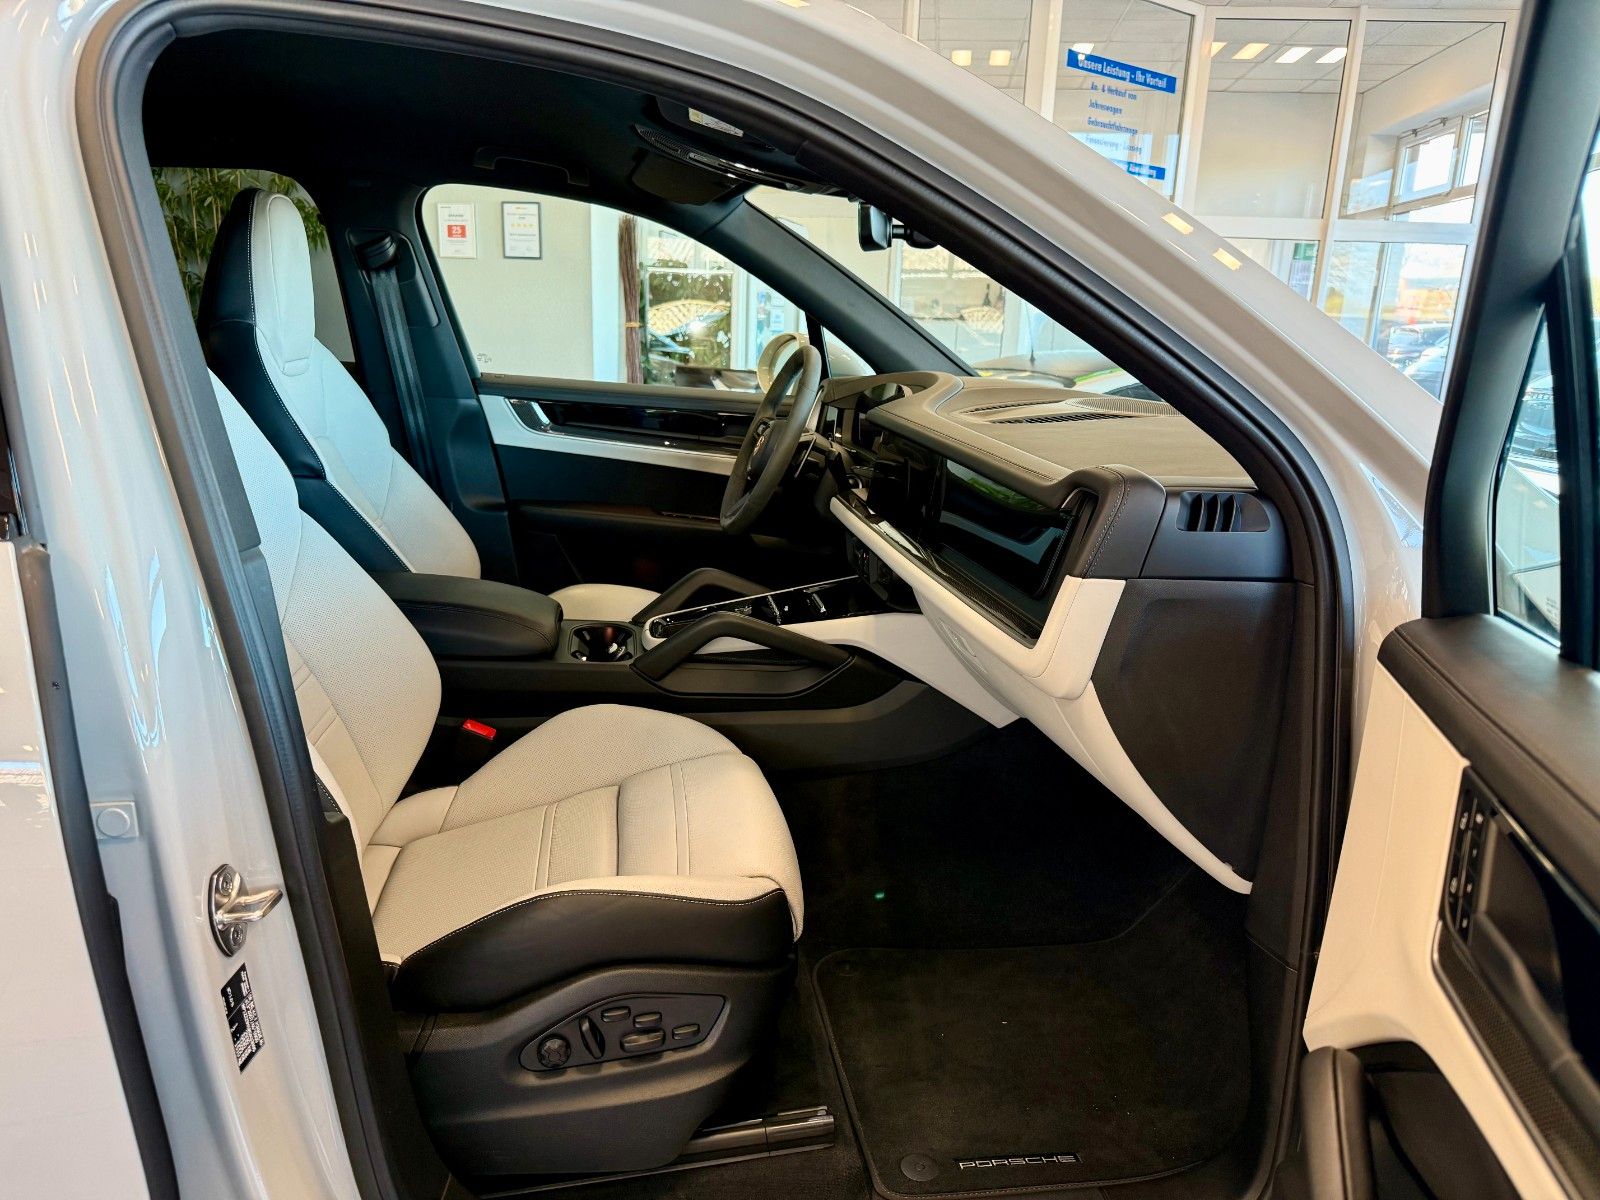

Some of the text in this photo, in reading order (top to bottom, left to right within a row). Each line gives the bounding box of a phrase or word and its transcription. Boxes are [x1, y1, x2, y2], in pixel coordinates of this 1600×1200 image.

[1103, 62, 1130, 82] Leistung
[1136, 70, 1146, 83] Ihr
[1146, 73, 1168, 88] Vorteil
[1089, 100, 1123, 115] Jahreswagen
[959, 1155, 1076, 1169] PORSCHE
